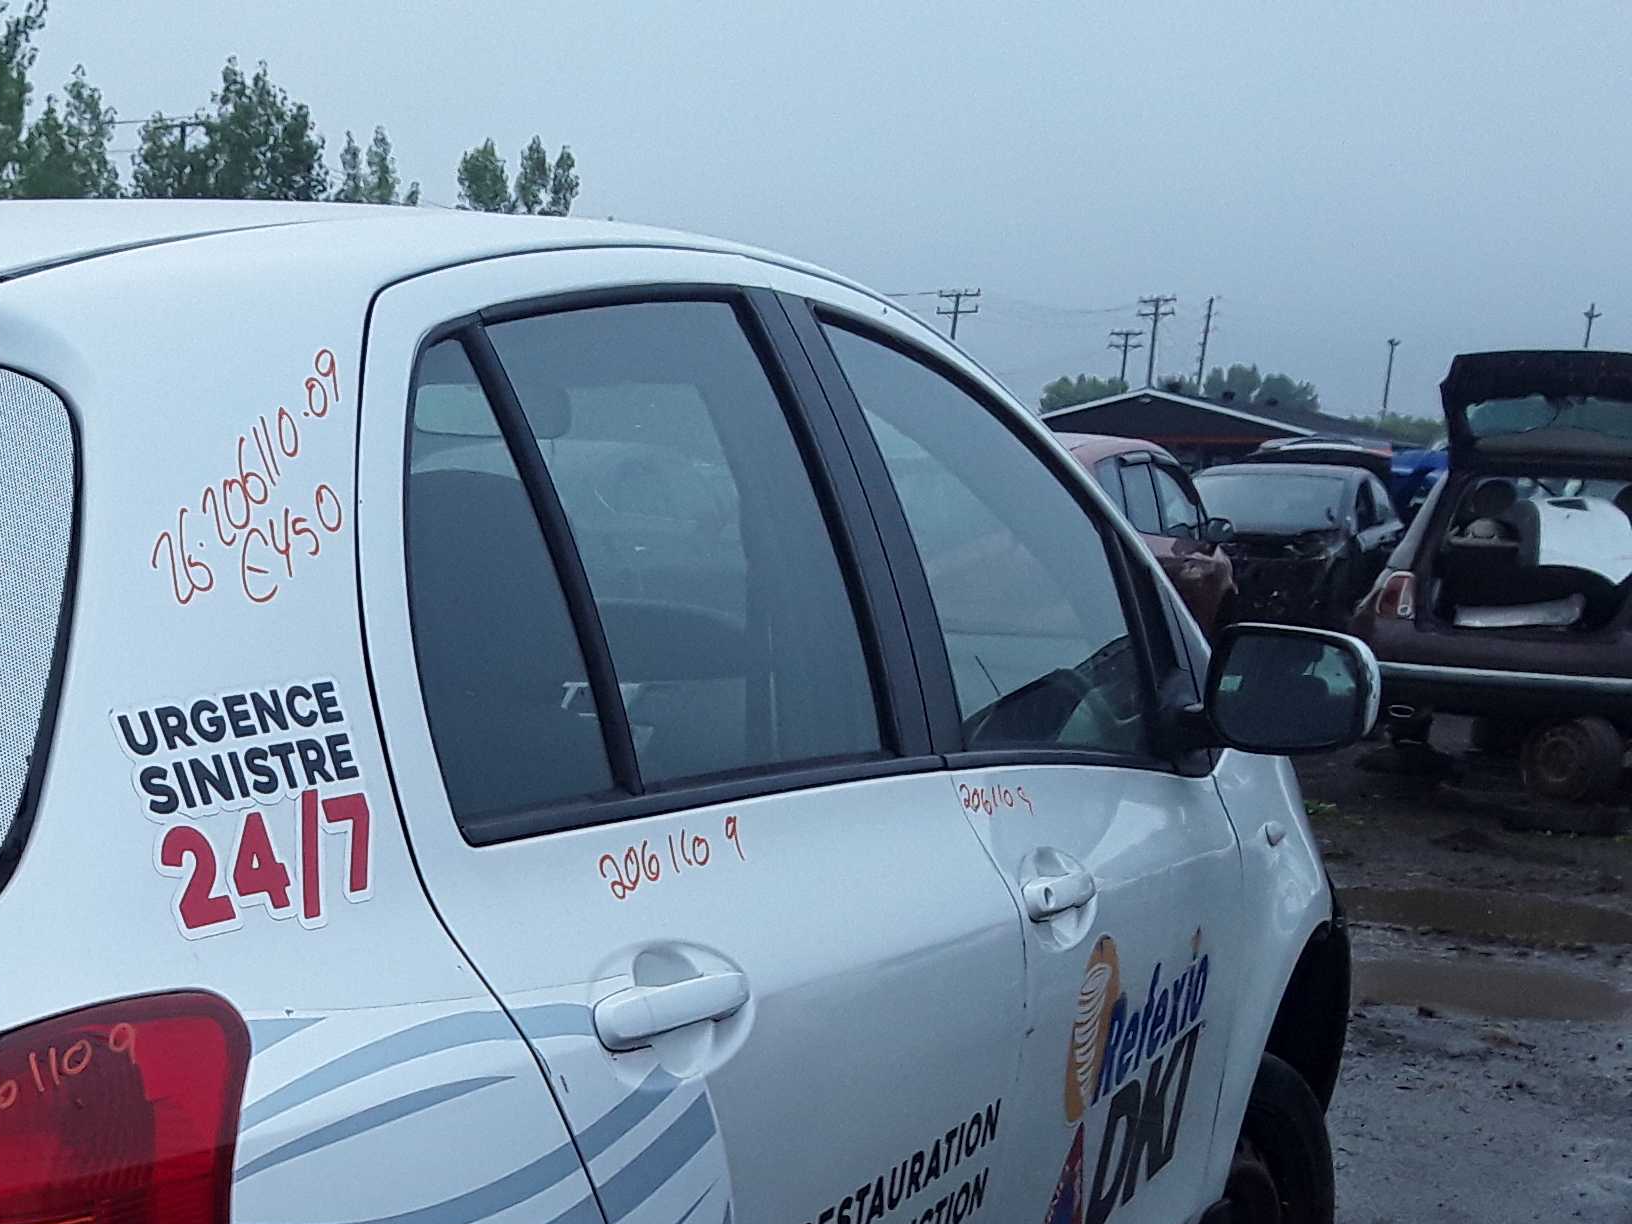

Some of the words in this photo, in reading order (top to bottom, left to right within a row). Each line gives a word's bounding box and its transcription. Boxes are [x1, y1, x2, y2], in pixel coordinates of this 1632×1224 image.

[117, 681, 344, 756] URGENCE
[139, 733, 360, 815] SINISTRE
[160, 788, 370, 930] 24/7
